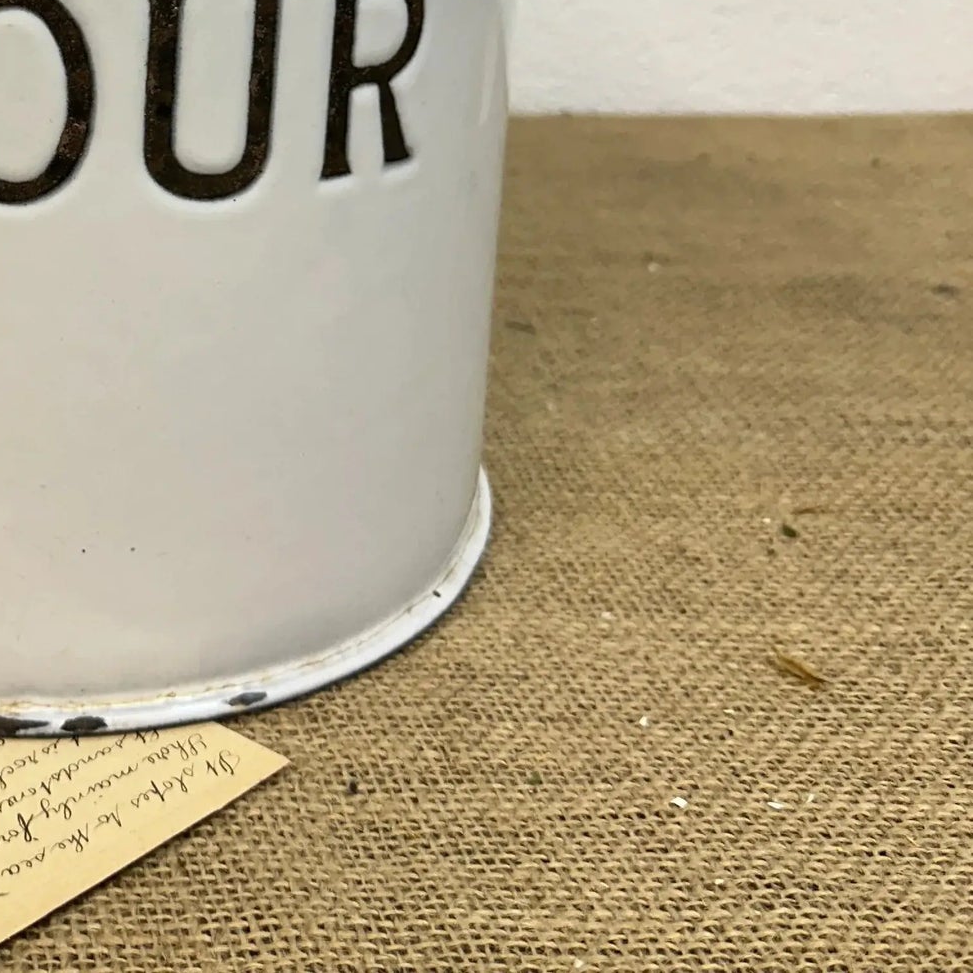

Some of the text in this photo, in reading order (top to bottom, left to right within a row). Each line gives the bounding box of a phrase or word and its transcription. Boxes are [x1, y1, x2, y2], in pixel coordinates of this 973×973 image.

[206, 750, 241, 775] It
[37, 762, 138, 820] mainly
[130, 763, 193, 808] slopes
[94, 803, 122, 828] to
[52, 823, 89, 852] the
[1, 847, 45, 877] sea
